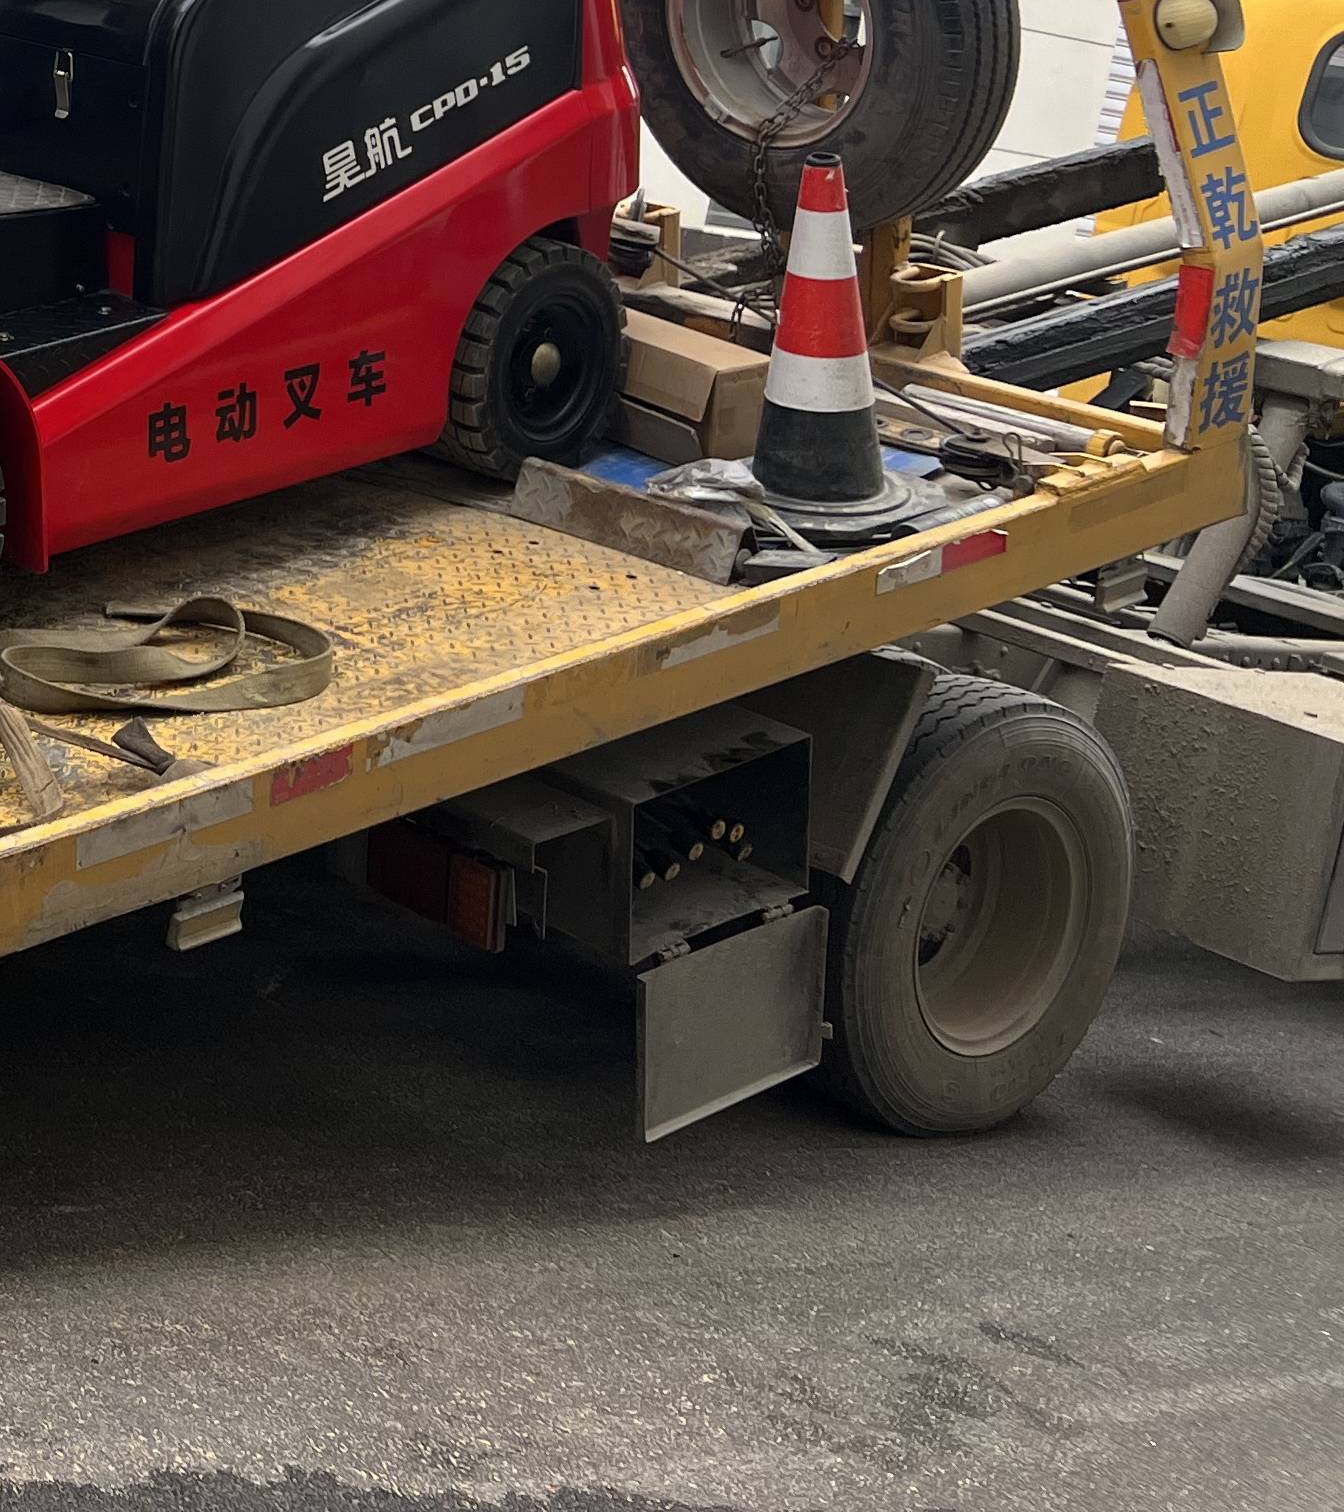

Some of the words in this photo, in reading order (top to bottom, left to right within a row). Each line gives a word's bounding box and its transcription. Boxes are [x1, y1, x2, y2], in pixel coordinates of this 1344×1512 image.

[1177, 80, 1260, 434] 正乾救援
[147, 350, 387, 463] 电动叉车
